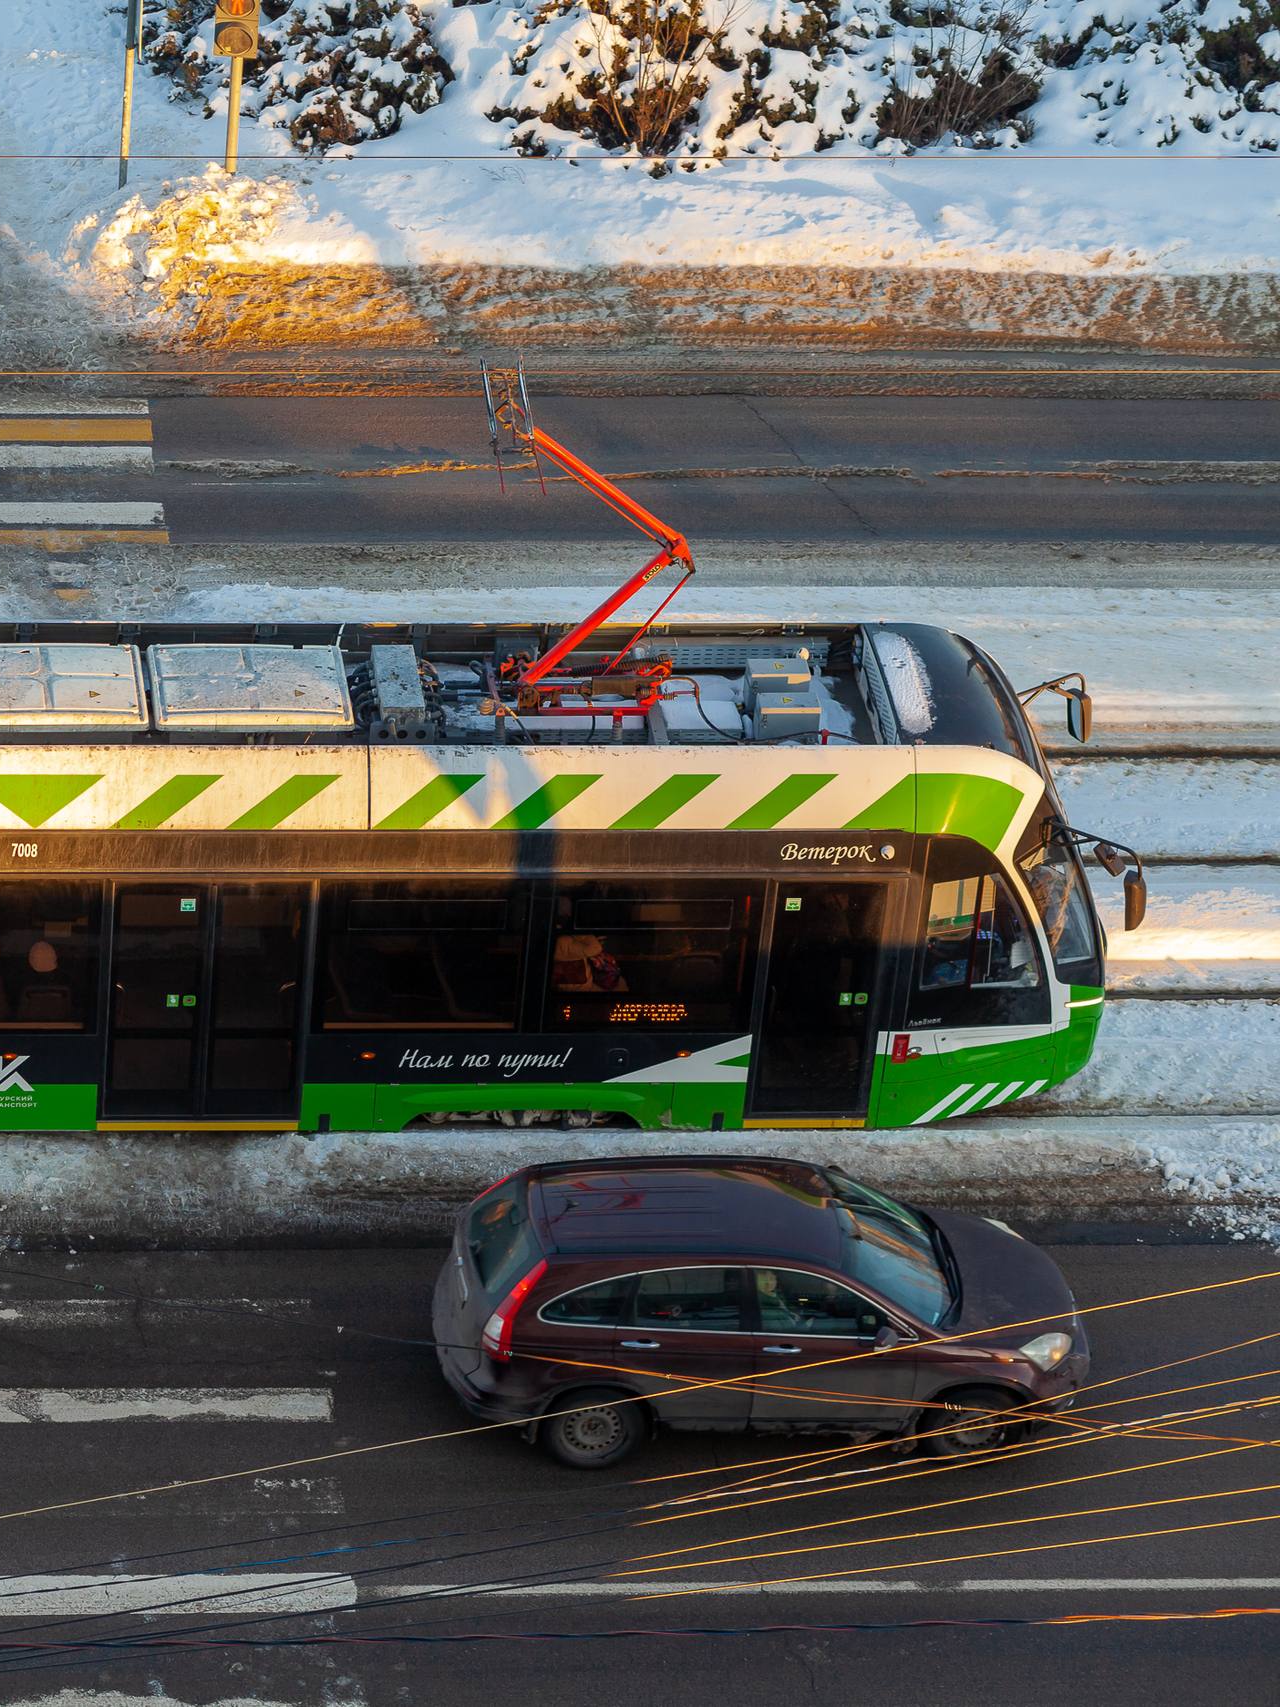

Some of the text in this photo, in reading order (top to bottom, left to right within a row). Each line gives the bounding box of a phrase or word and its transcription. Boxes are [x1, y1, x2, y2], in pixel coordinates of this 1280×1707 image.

[11, 843, 38, 858] 7008
[780, 843, 876, 866] Ветерок
[398, 1047, 573, 1078] Нам по пути!
